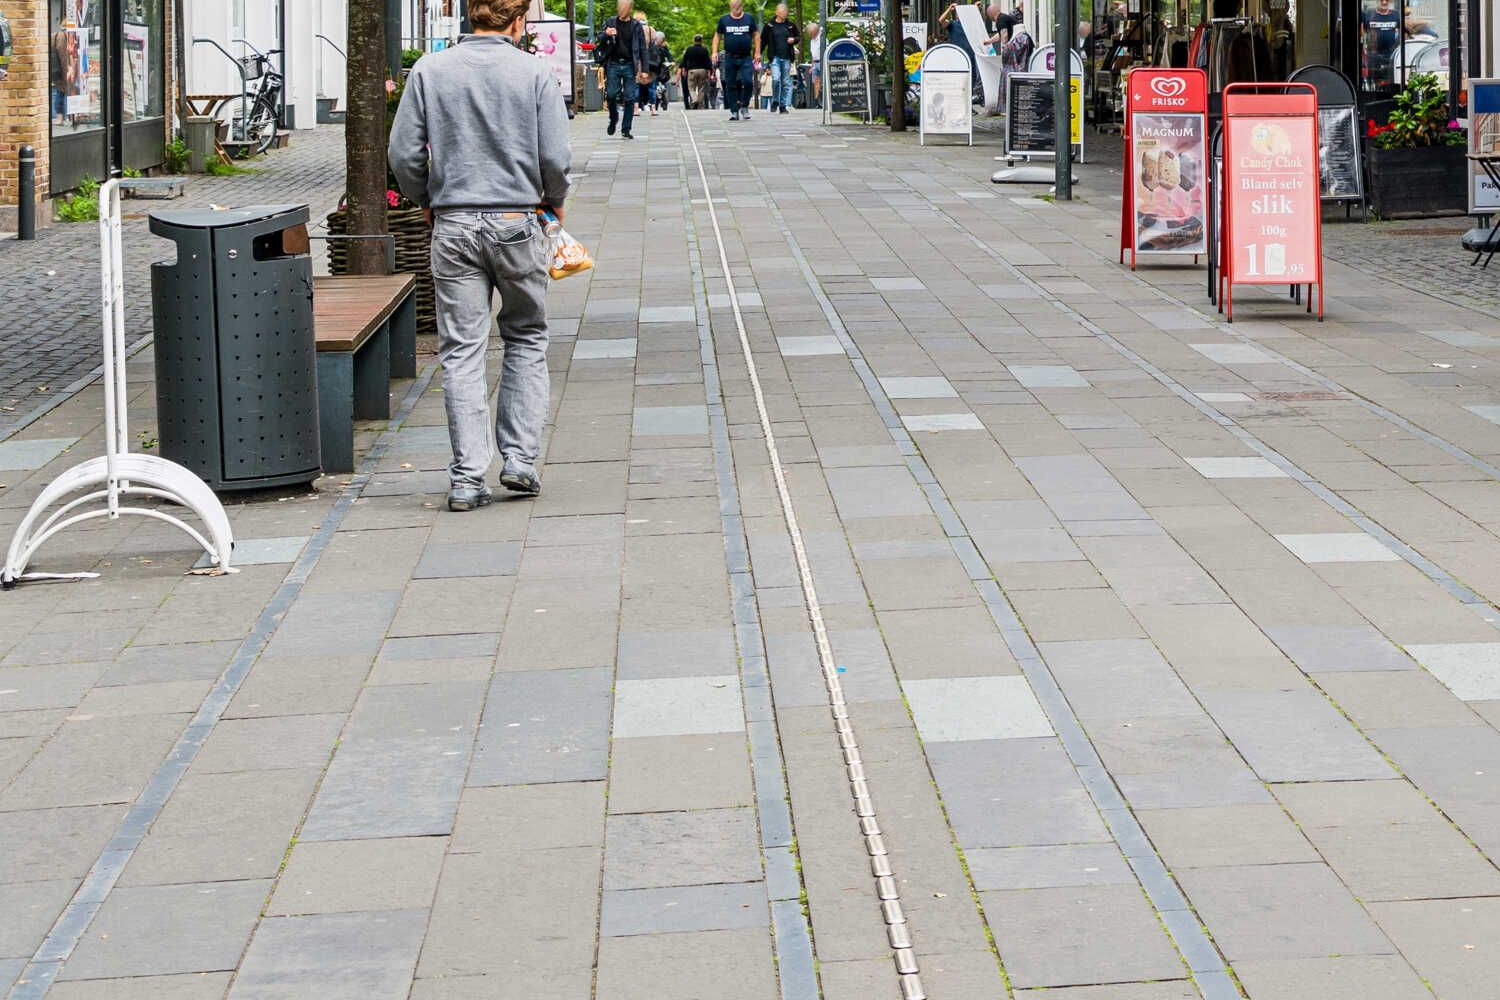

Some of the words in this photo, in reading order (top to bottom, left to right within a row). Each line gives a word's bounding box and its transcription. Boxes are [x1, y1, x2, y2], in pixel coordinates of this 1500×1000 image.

[1152, 97, 1185, 106] FRISKO
[1142, 127, 1194, 137] MAGNUM
[1240, 154, 1272, 171] Candy
[1275, 154, 1304, 169] Chok
[1241, 177, 1277, 190] Bland
[1280, 177, 1304, 190] selv
[1251, 193, 1296, 215] slik
